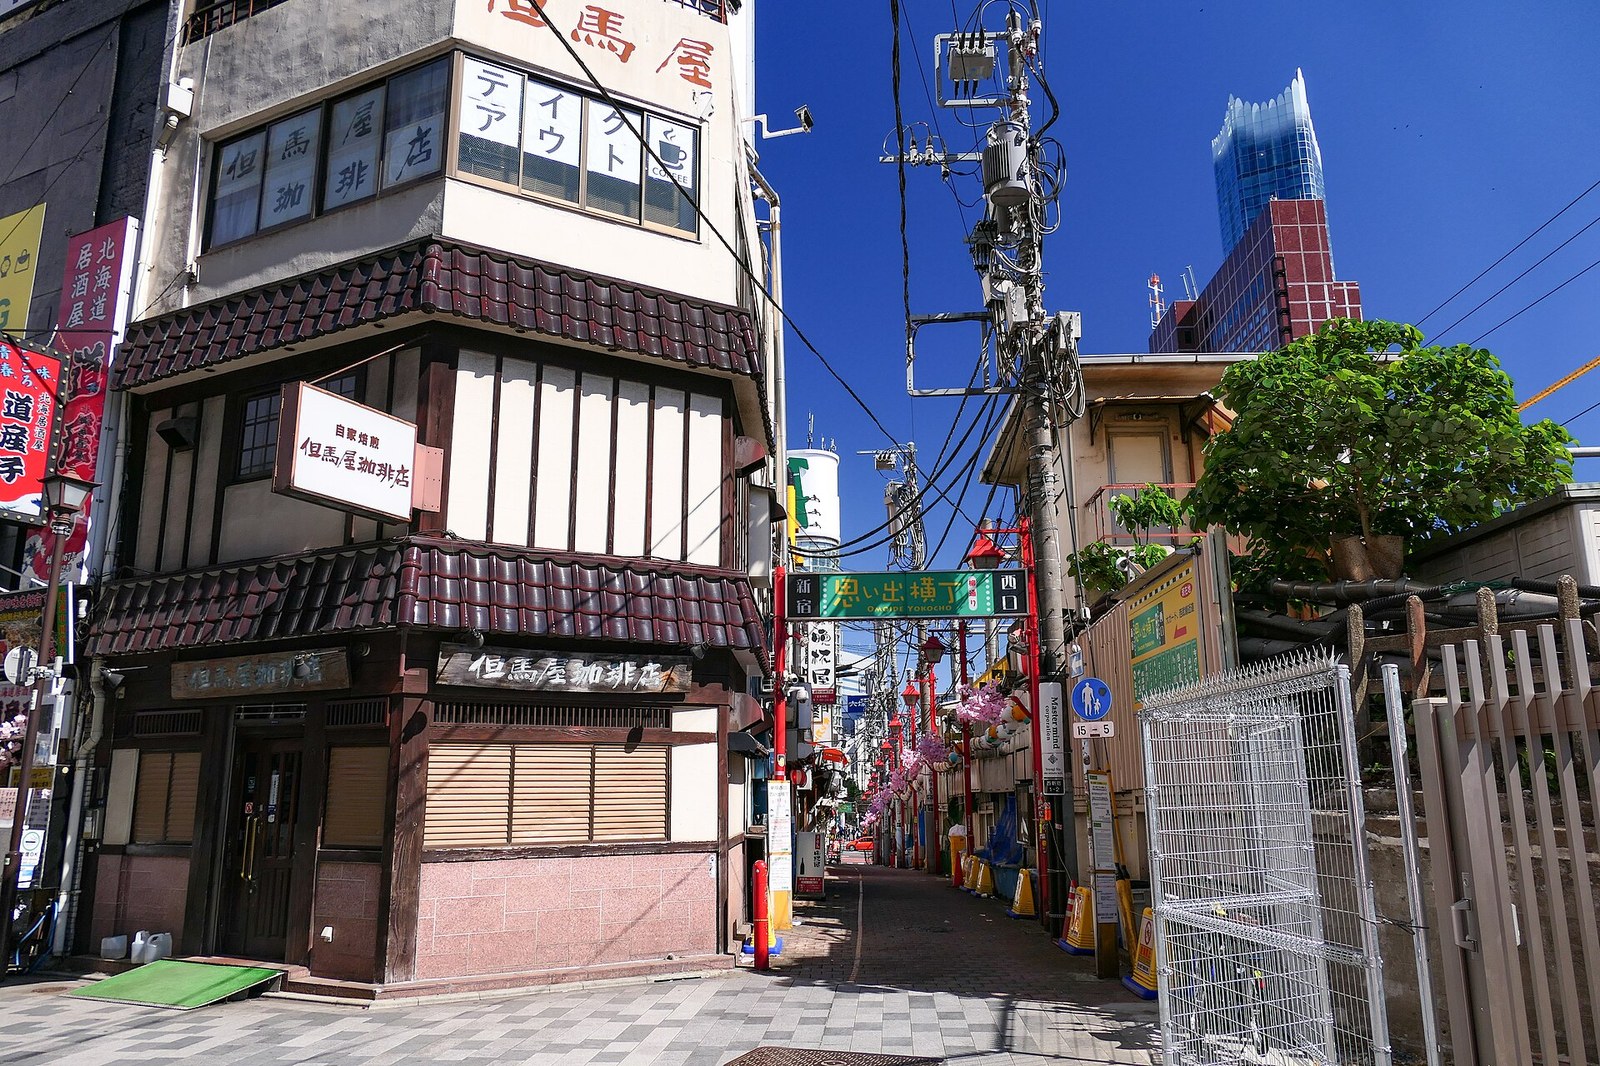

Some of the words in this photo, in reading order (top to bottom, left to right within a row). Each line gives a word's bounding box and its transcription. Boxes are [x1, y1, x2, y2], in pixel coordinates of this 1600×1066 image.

[477, 69, 626, 135] テイク
[226, 100, 375, 181] 但馬屋
[476, 104, 624, 172] アウト
[273, 126, 432, 214] 珈琲店
[65, 243, 94, 329] 居酒屋
[88, 236, 116, 322] 北海道
[0, 388, 34, 484] 道産子
[299, 436, 410, 489] 但馬屋珈琲店
[335, 423, 380, 449] 自家焙煎
[796, 578, 812, 614] 新宿
[832, 577, 962, 608] 思い出横丁
[866, 605, 904, 613] OMOIDE
[907, 604, 952, 612] YOKOCHO
[1000, 574, 1018, 611] 西口
[468, 651, 662, 691] 但馬屋珈琲店
[1077, 725, 1087, 736] 15
[1103, 724, 1110, 735] 5
